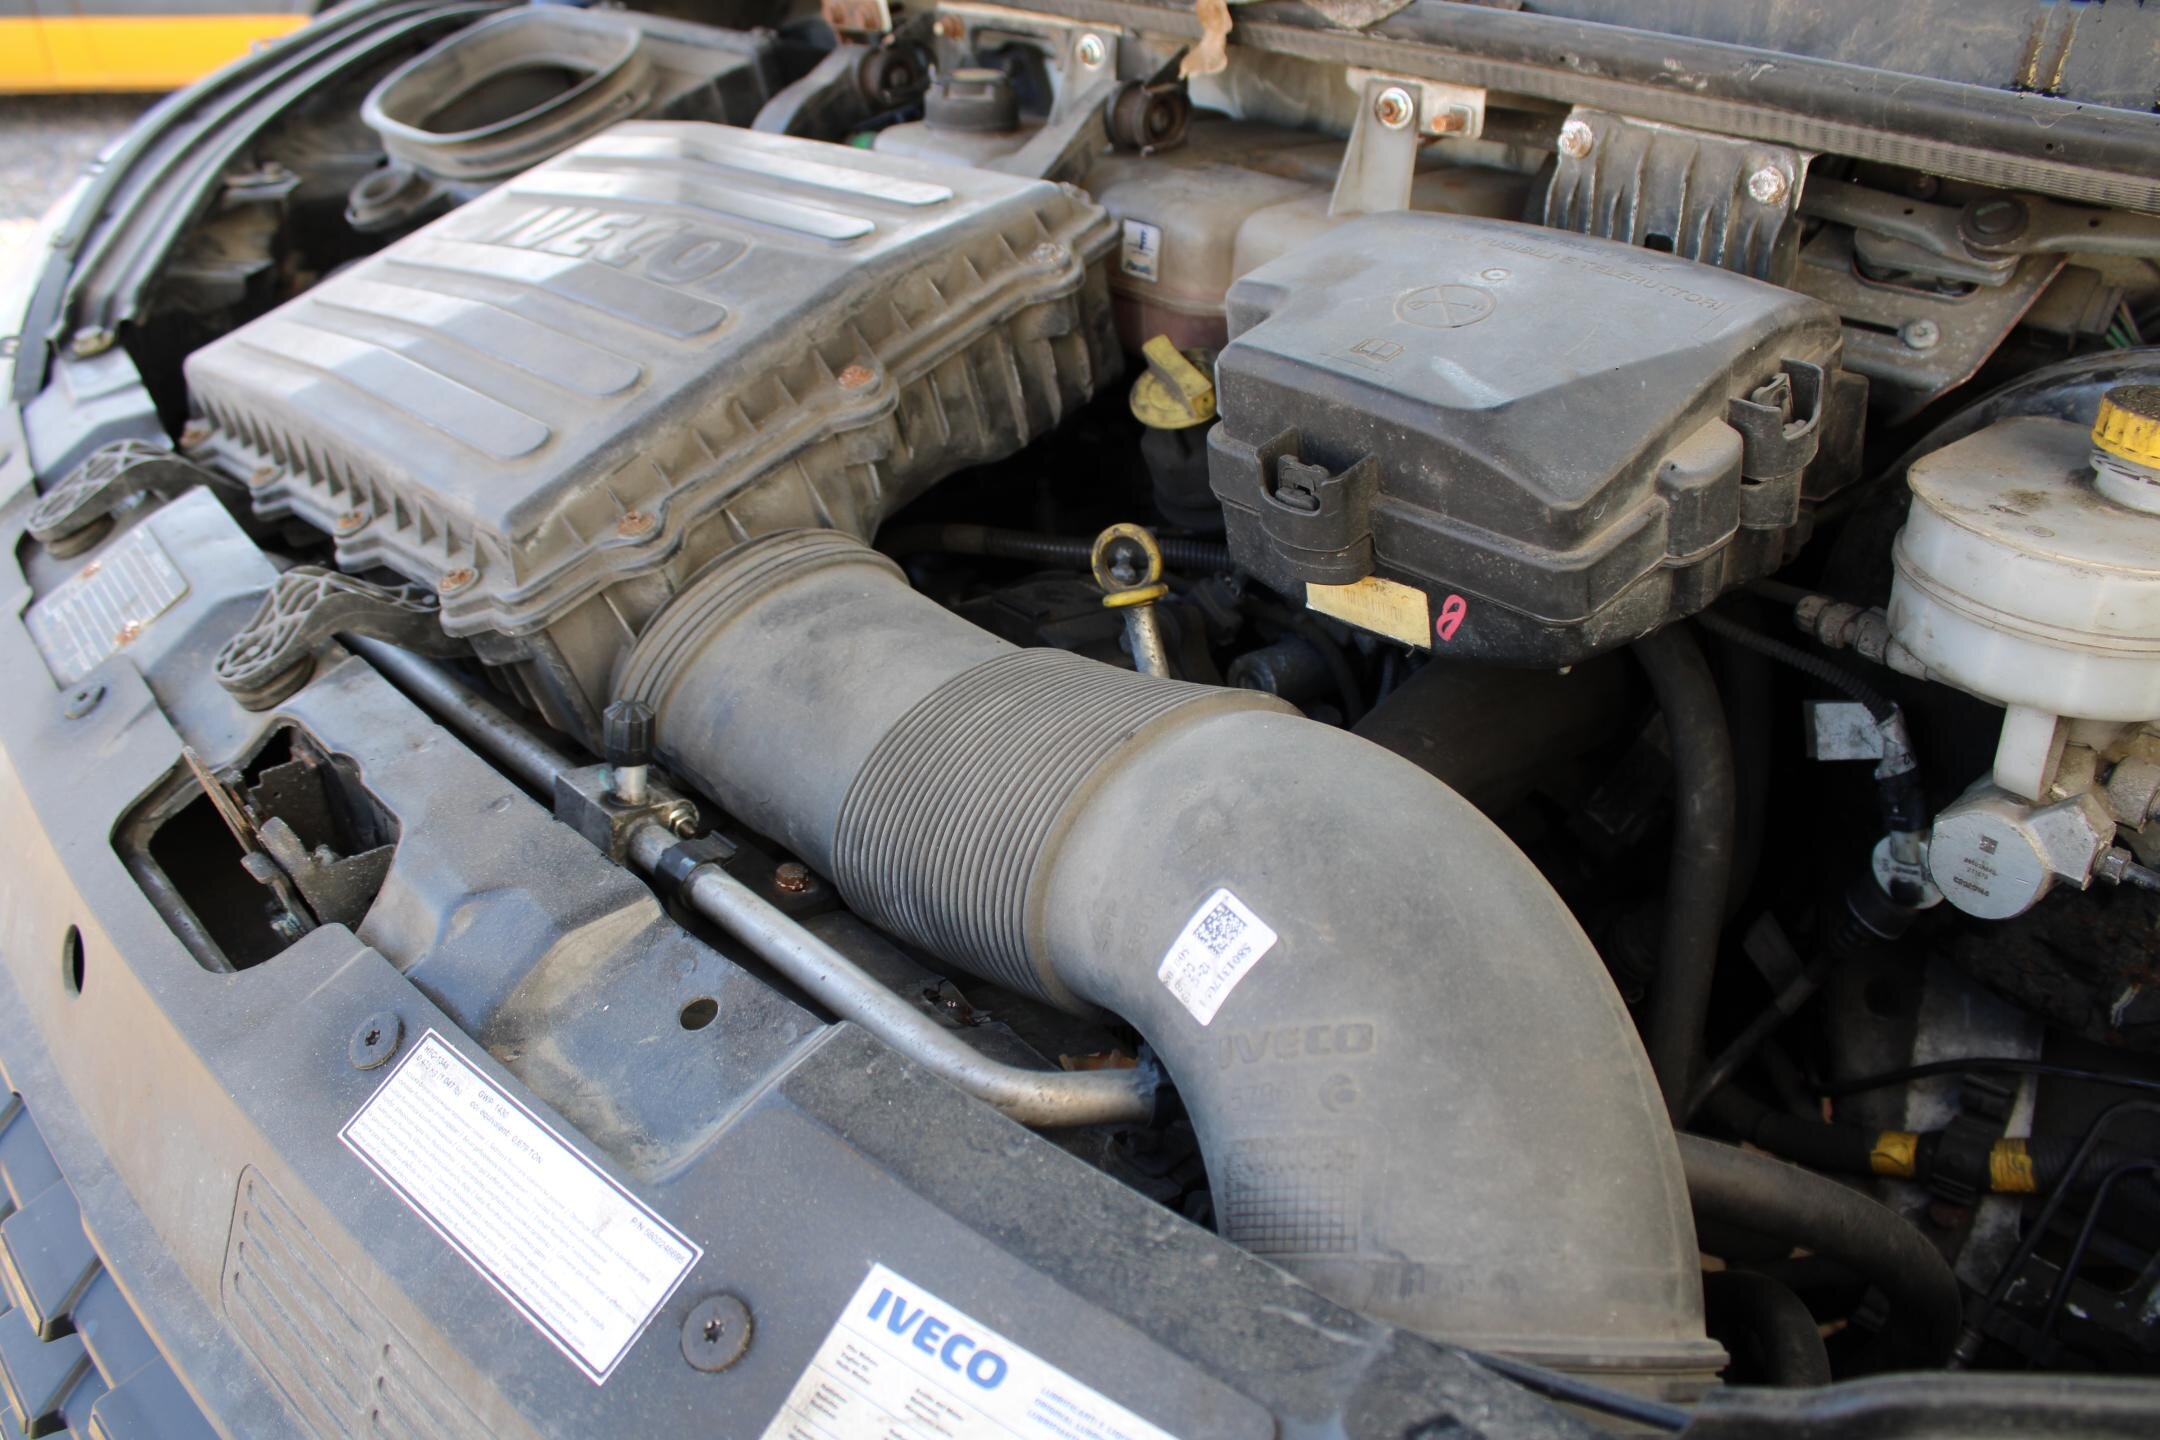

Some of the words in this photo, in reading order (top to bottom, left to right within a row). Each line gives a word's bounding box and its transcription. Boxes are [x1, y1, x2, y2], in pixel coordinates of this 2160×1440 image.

[489, 205, 753, 285] IVECO
[1217, 1022, 1374, 1069] IVECO
[867, 1287, 1008, 1391] IVECO
